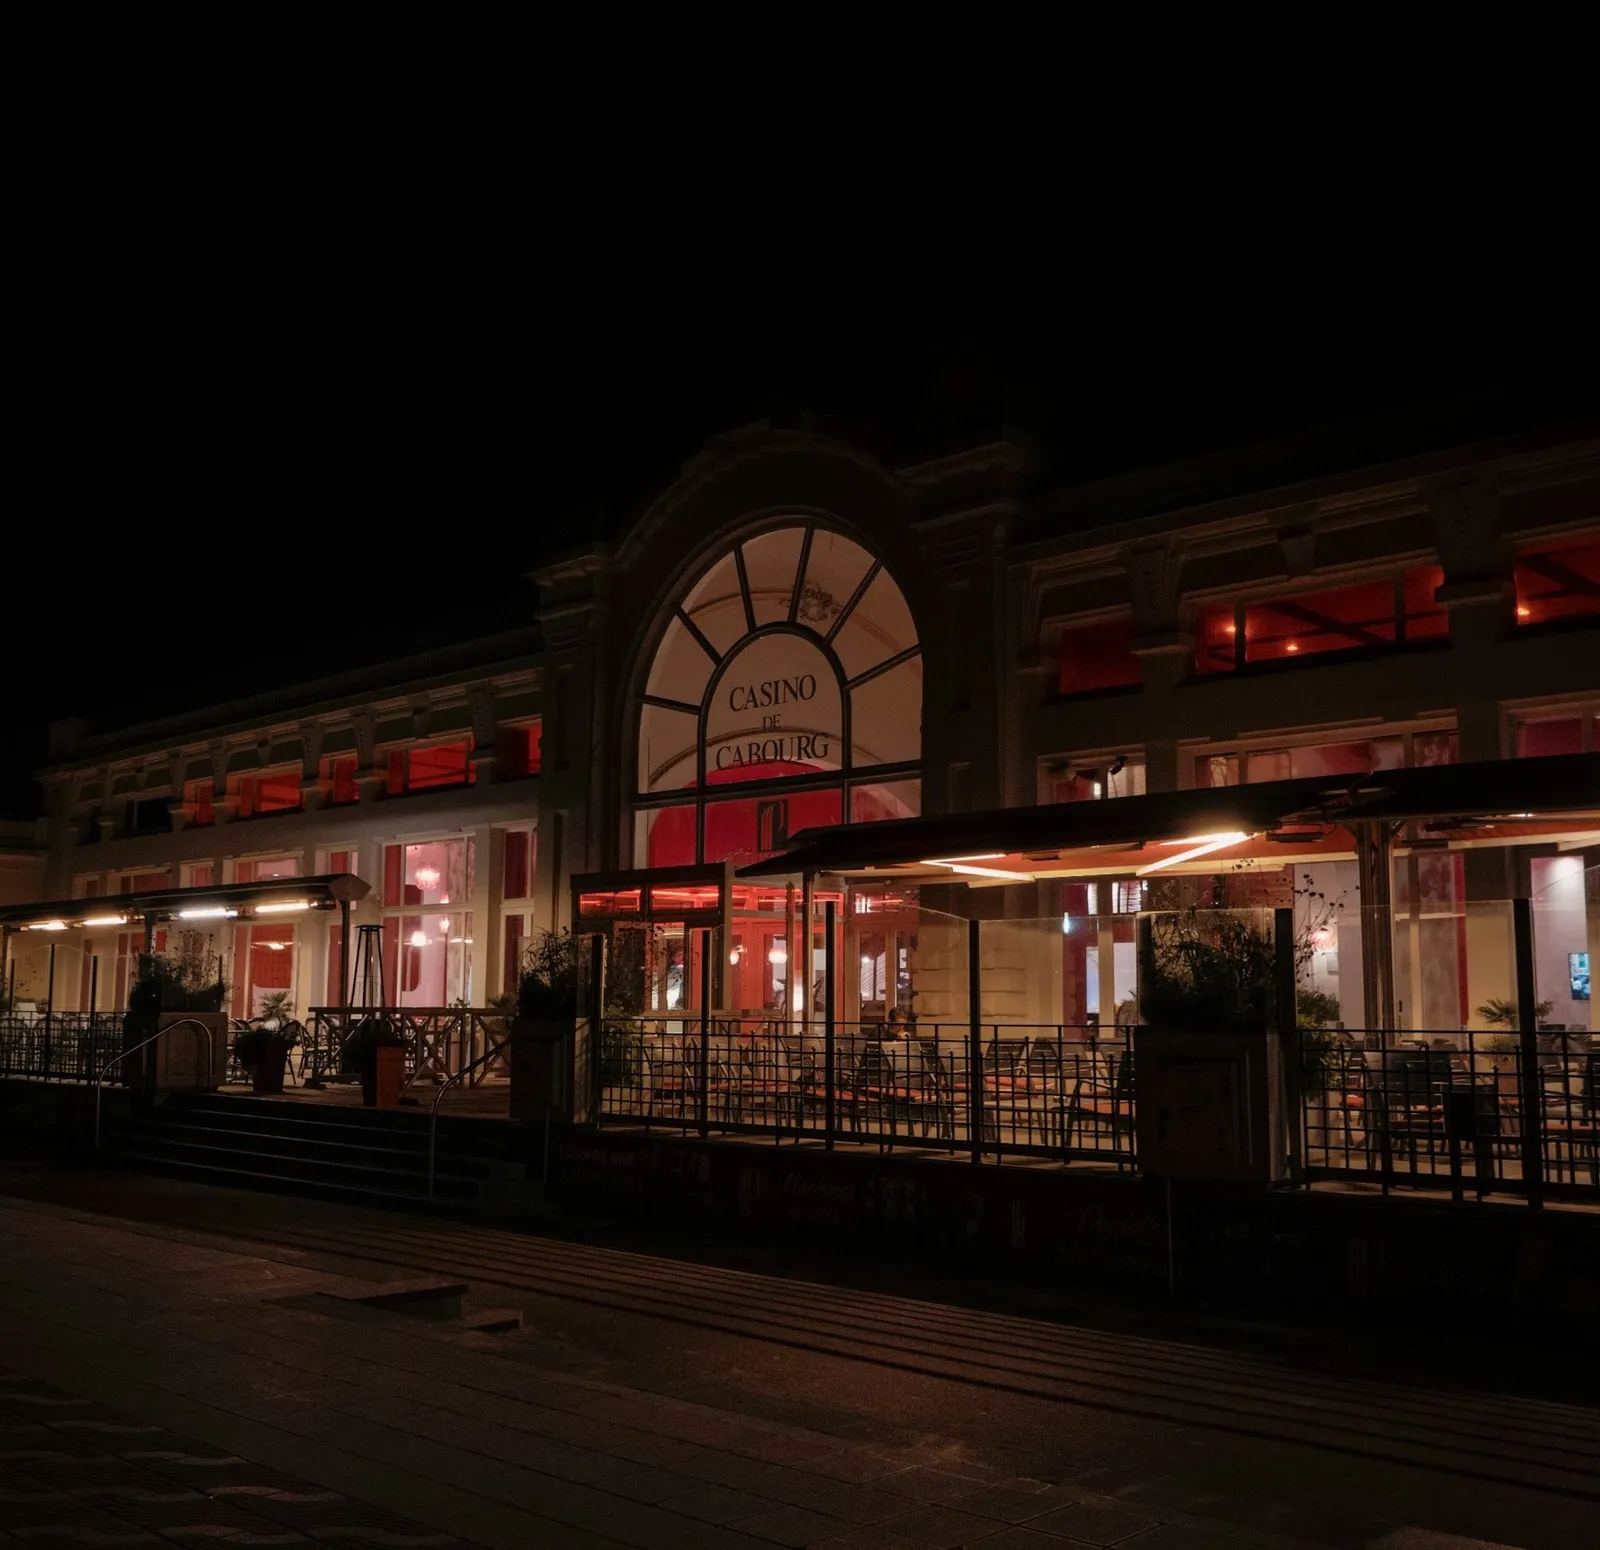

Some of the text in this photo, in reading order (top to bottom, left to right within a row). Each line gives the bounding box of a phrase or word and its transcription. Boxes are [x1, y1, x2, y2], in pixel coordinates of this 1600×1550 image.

[729, 674, 817, 712] CASINO
[762, 713, 782, 732] DE
[715, 732, 830, 770] CABOURG
